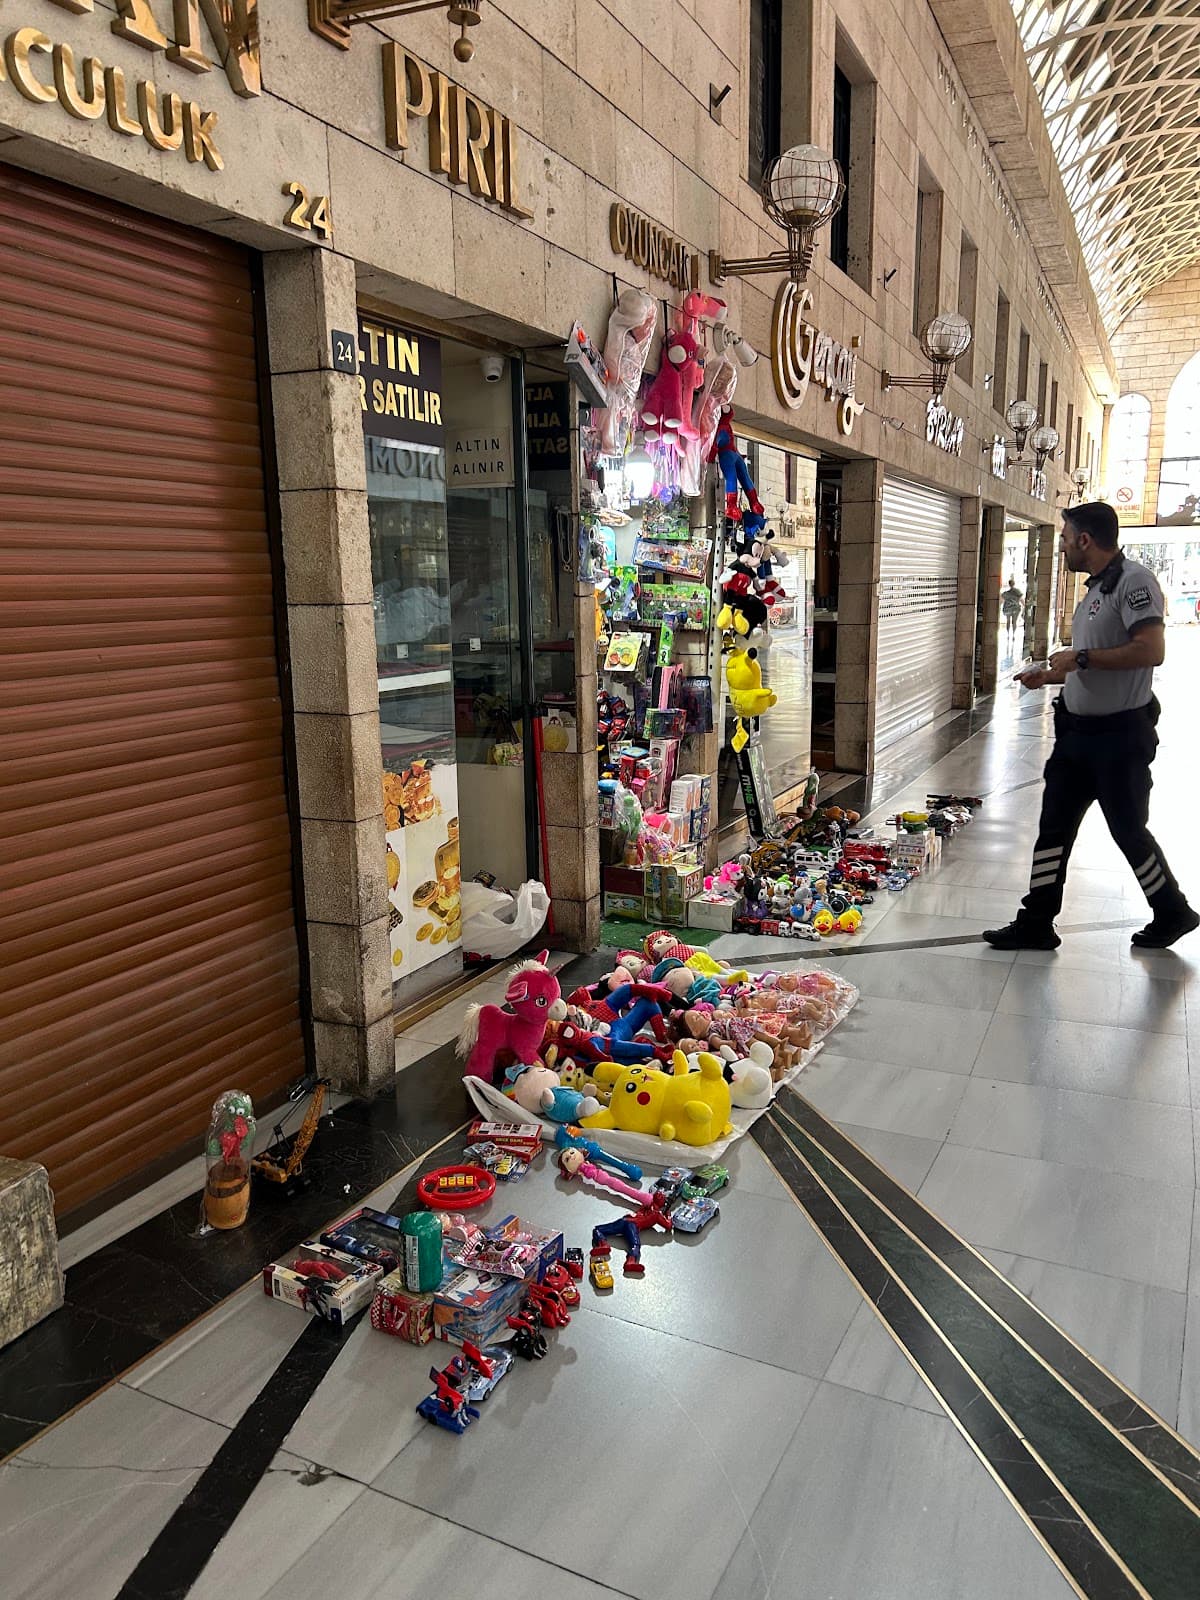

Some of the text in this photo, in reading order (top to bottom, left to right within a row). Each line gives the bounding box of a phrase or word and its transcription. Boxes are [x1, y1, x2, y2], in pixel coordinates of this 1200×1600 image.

[0, 27, 224, 171] CULUK
[381, 42, 534, 219] PIRIL
[281, 182, 333, 240] 24
[337, 341, 352, 363] 24
[372, 379, 443, 426] SATILIR
[453, 461, 505, 475] ALINIR
[455, 438, 500, 453] ALTIN
